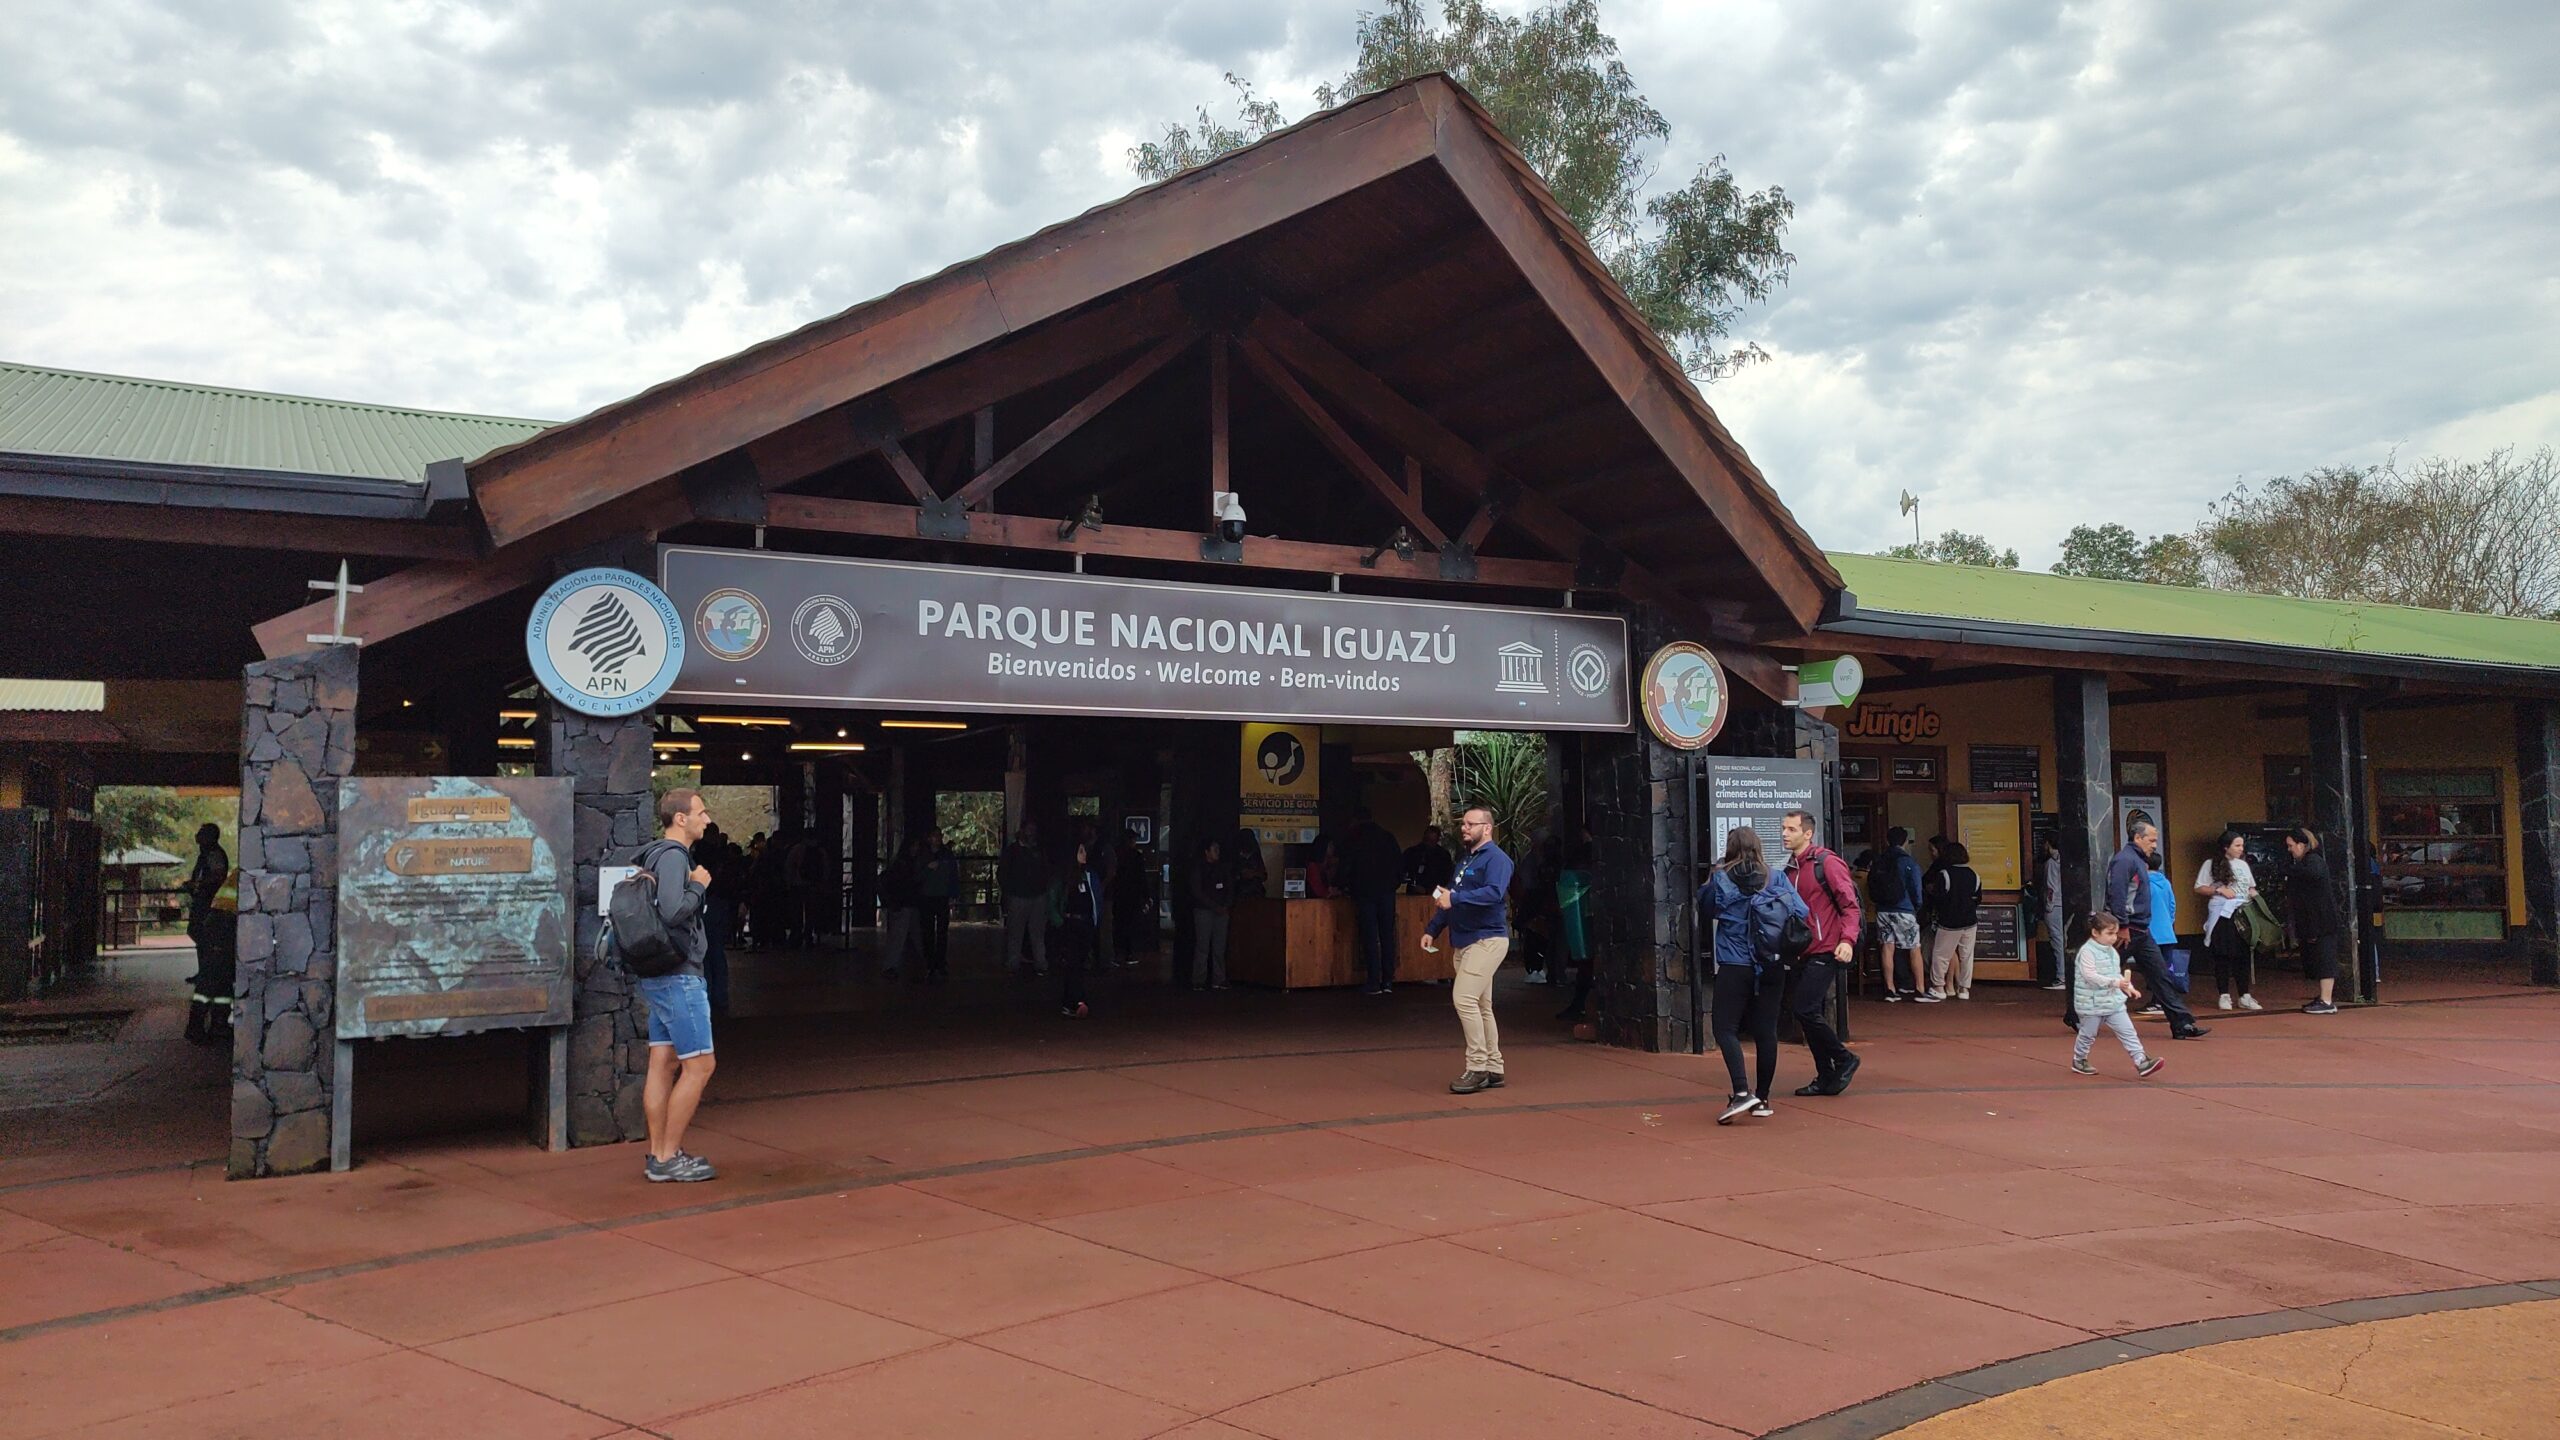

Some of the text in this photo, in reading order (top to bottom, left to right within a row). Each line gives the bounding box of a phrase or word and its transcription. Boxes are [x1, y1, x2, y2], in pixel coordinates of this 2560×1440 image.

[590, 573, 603, 582] de
[604, 573, 651, 594] PARQUES
[649, 592, 681, 649] NACIONALES
[918, 599, 1457, 665] PARQUE NACIONAL IGUAZÚ
[818, 645, 836, 654] APN
[988, 652, 1401, 693] Bienvenidos Welcome Bem-vindos
[1500, 655, 1543, 683] UNESCO
[585, 676, 628, 693] APN
[555, 685, 656, 712] ARGENTINA
[1847, 703, 1940, 744] Jungle
[1715, 778, 1731, 789] Aquí
[1740, 778, 1777, 787] cometieron
[1715, 789, 1812, 799] crímenes de lesa humanidad
[470, 801, 508, 816] Falls
[1243, 799, 1281, 809] SERVICIO
[1283, 799, 1296, 809] DE
[1715, 801, 1739, 809] durante
[1775, 801, 1783, 809] de
[1783, 801, 1802, 809] Estado
